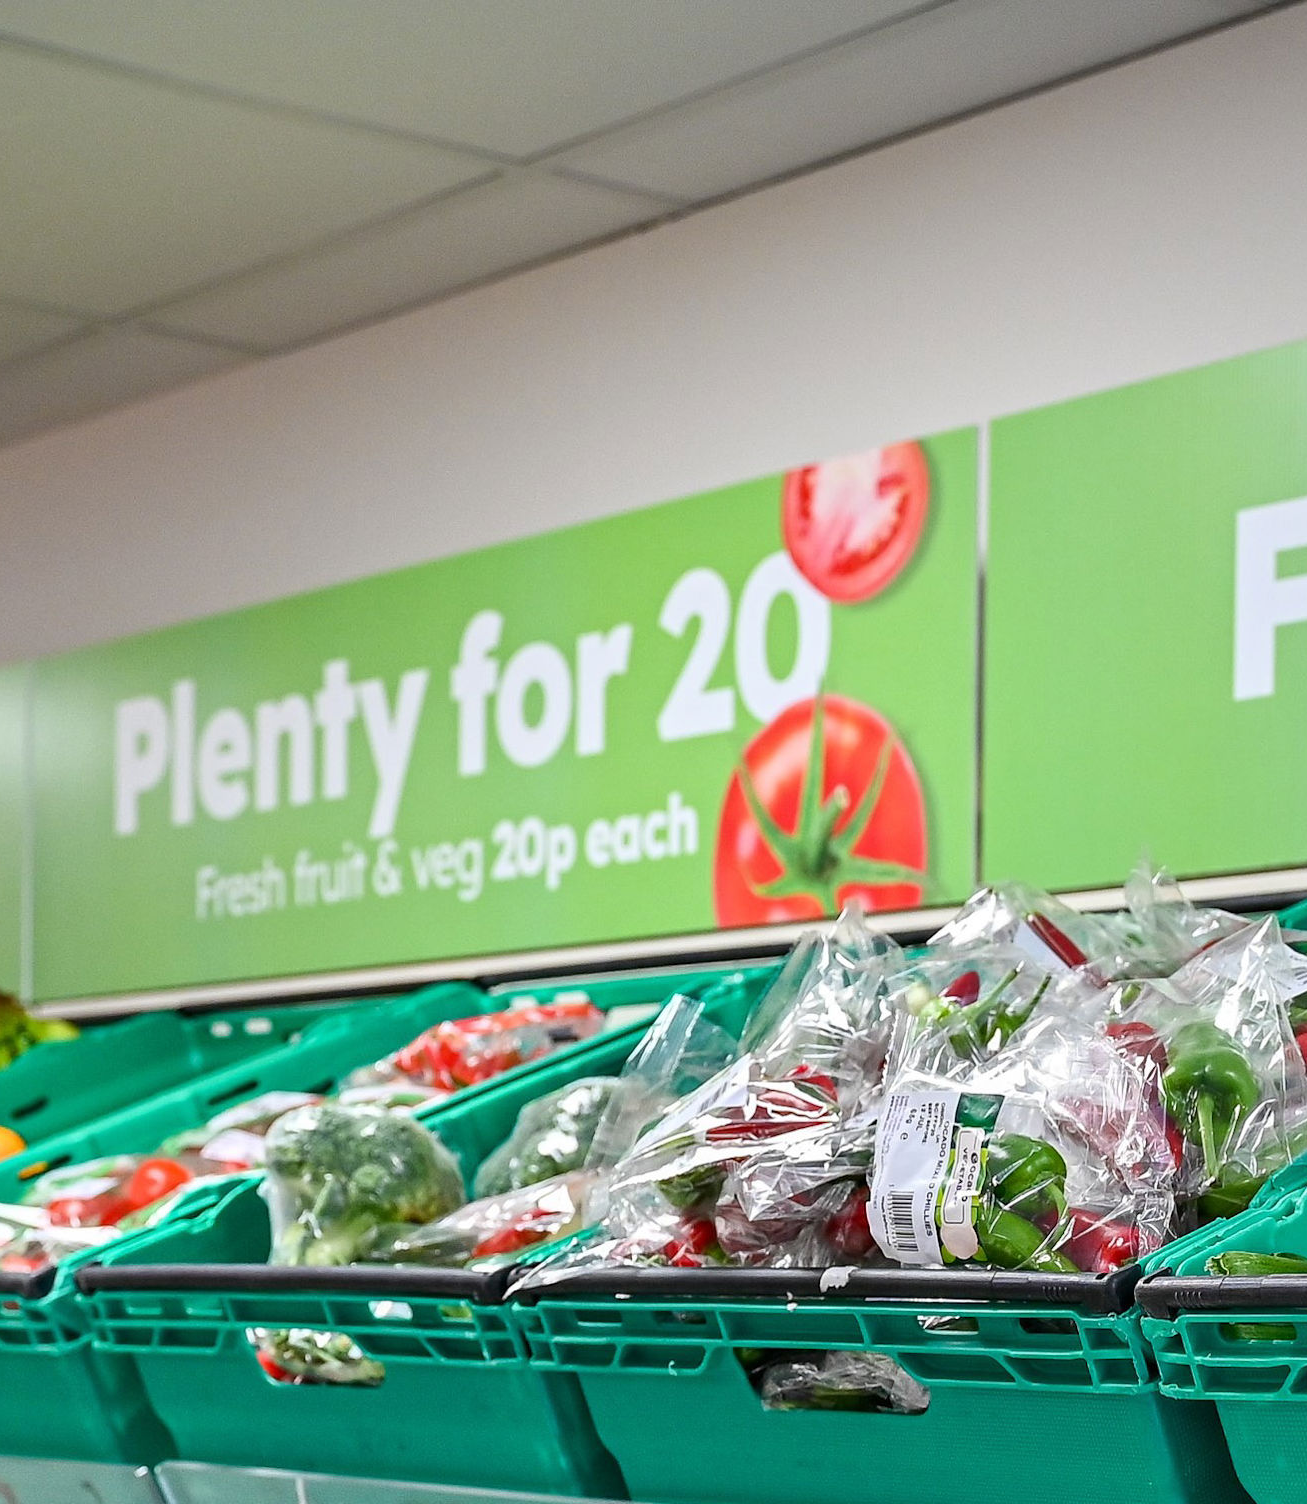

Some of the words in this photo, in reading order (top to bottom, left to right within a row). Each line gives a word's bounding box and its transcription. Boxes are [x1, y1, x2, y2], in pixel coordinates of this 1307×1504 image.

[114, 658, 428, 838] Plenty
[450, 610, 631, 777] for
[656, 550, 831, 741] 20
[196, 863, 285, 920] Fresh
[293, 843, 364, 905] fruit
[376, 839, 401, 897] &
[412, 839, 484, 904] veg
[493, 825, 575, 892] 20p
[587, 794, 697, 864] each
[939, 1121, 949, 1158] OCADO
[923, 1192, 933, 1237] CHILLIES
